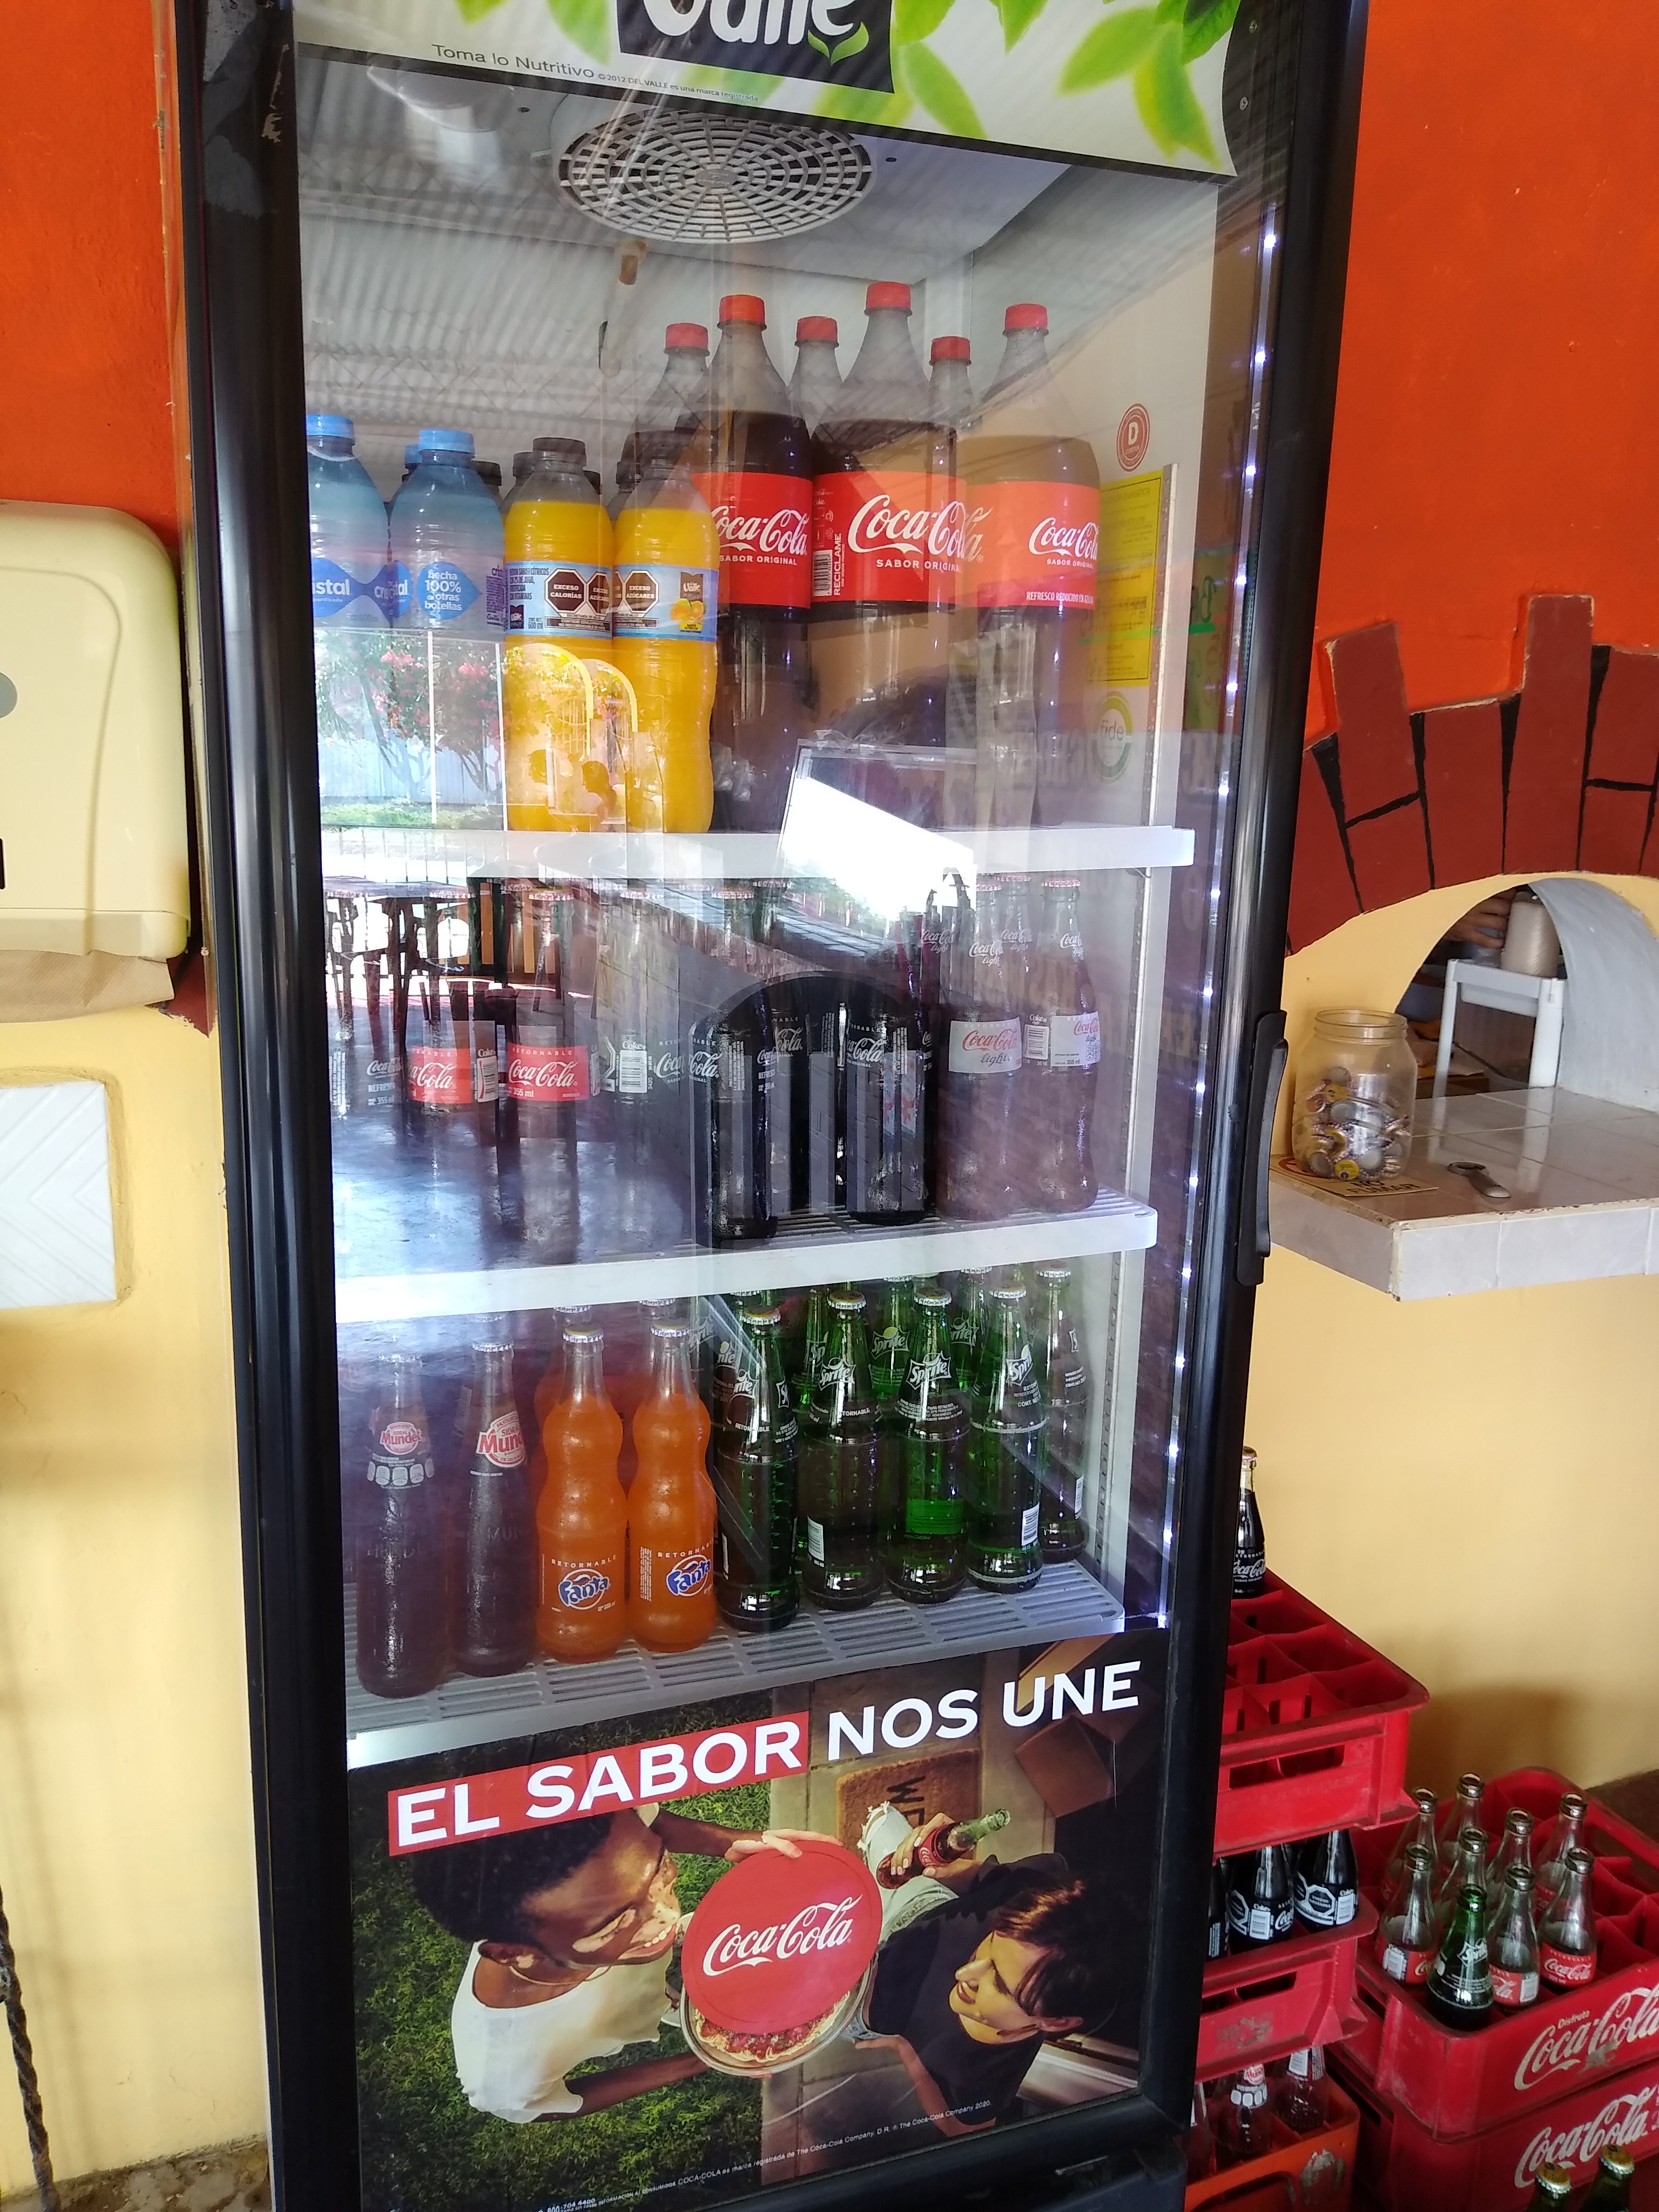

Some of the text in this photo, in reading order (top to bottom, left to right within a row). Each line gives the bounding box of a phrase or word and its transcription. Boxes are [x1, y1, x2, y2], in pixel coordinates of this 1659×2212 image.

[431, 44, 595, 78] Toma lo Nutritivo
[628, 77, 643, 85] DEL
[644, 79, 668, 89] VALLE
[697, 87, 719, 96] marca
[847, 494, 994, 563] Coca-Cola
[757, 556, 797, 566] ORIGINAL
[834, 533, 842, 596] RECICLAME
[876, 559, 961, 573] SABOR ORIGINAL
[1047, 558, 1071, 566] SABOR
[424, 580, 462, 593] 100%
[1026, 591, 1055, 601] REFRESCO
[424, 601, 462, 611] botellas
[1029, 1014, 1044, 1022] Coke
[622, 1041, 642, 1050] Coke
[848, 1037, 888, 1062] ca-Cola
[962, 1028, 1018, 1051] Coca-Cola
[512, 1048, 572, 1056] RETORNABLE
[509, 1058, 578, 1087] Coca-Cola
[513, 1087, 534, 1097] 355 ml
[1346, 1183, 1420, 1193] FUMAR
[872, 1333, 905, 1354] Sprite
[819, 1366, 851, 1386] Sprite
[909, 1360, 947, 1384] Sprite
[839, 1407, 871, 1417] TORNABLE
[735, 1422, 770, 1432] RETORABLE
[381, 1430, 421, 1445] Mundet
[551, 1554, 616, 1568] RETORNABLE
[666, 1559, 711, 1595] Fanta
[559, 1576, 609, 1607] Fanta
[397, 1661, 1142, 1848] EL SABOR NOS UNE
[703, 1894, 863, 1977] Coca-Cola
[1544, 1958, 1592, 1980] Coca-Cola
[1514, 1983, 1659, 2090] Coca-Cola
[678, 2169, 721, 2186] COCA-COLA
[732, 2162, 752, 2172] marca
[796, 2147, 809, 2155] The
[810, 2139, 843, 2152] Coca-Cola
[899, 2121, 911, 2129] The
[912, 2113, 944, 2125] Coca-Cola
[945, 2106, 974, 2117] Company
[1514, 2084, 1659, 2188] Coca-Cola
